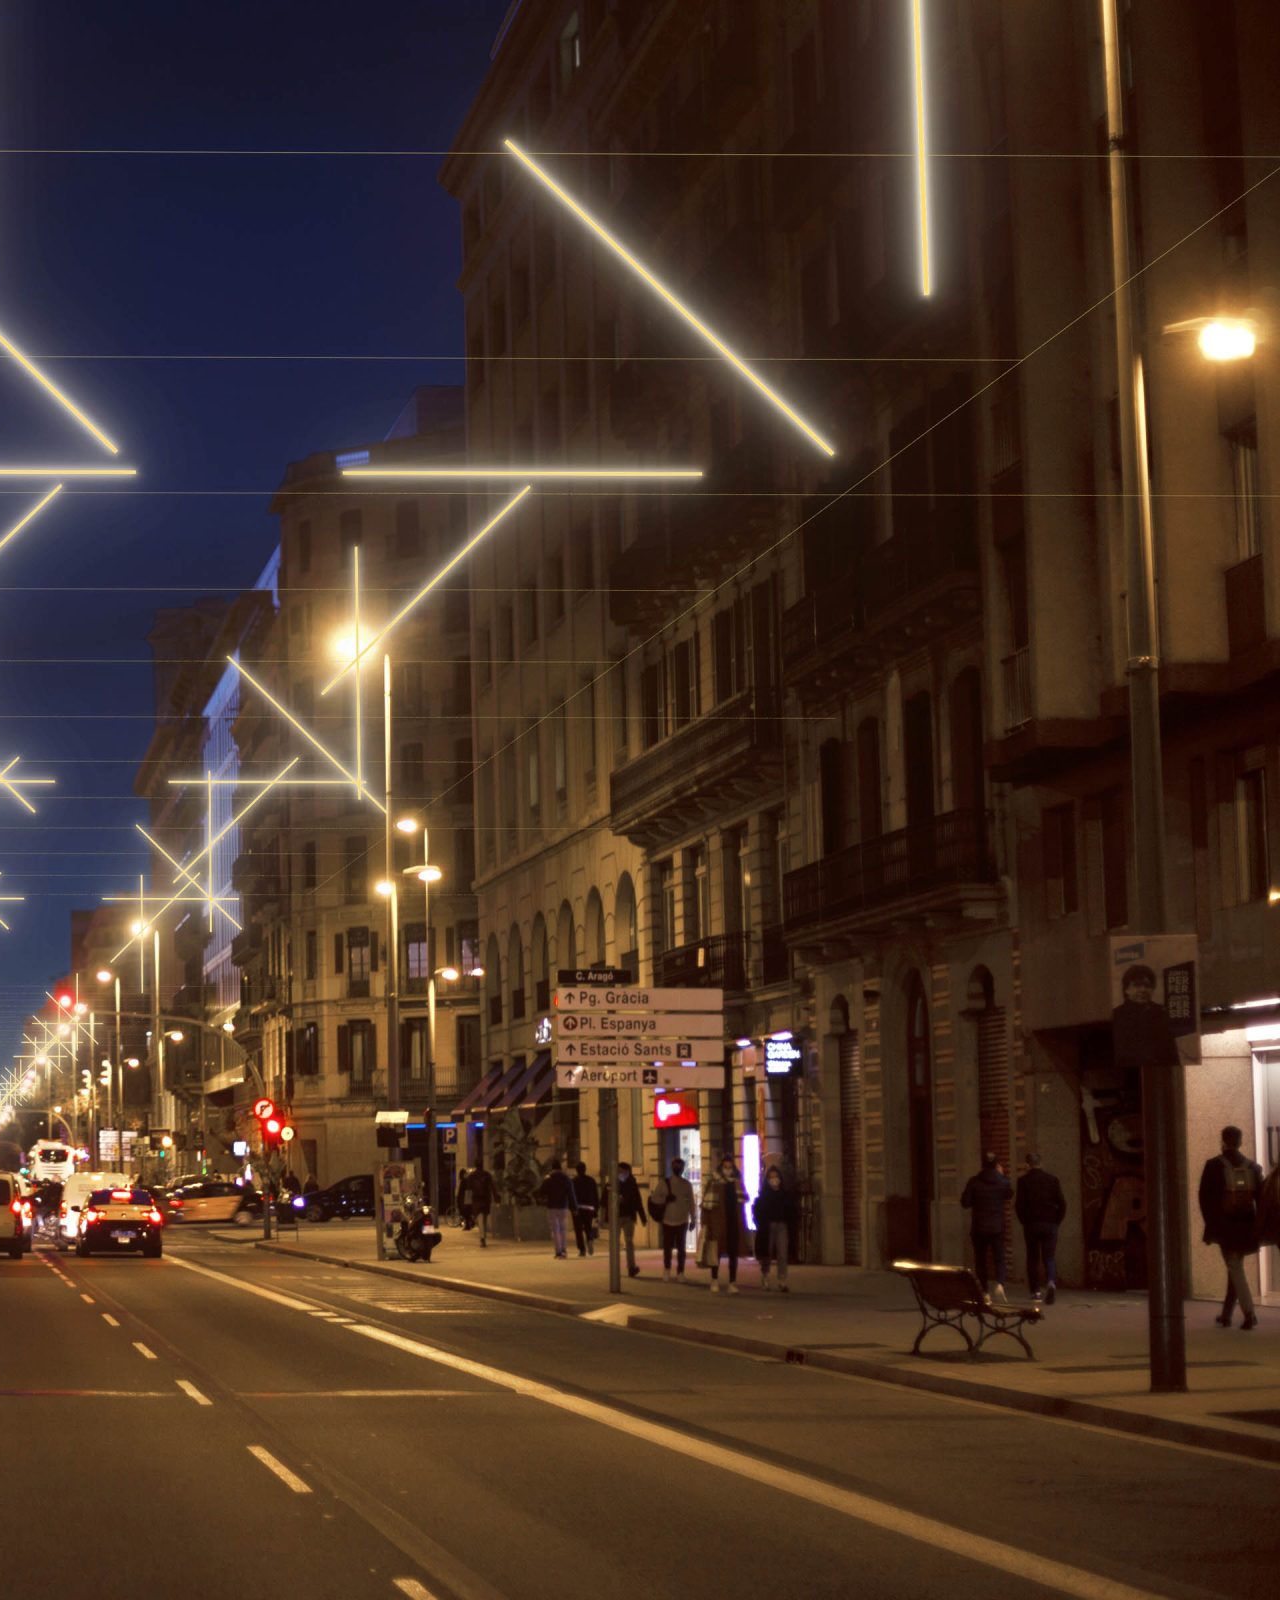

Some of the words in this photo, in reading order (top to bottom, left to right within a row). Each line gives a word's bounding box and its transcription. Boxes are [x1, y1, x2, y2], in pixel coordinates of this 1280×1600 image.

[576, 971, 586, 981] C.
[587, 971, 614, 982] Aragó
[579, 991, 601, 1007] Pg.
[605, 991, 649, 1004] Gràcia
[580, 1016, 596, 1030] Pl.
[601, 1017, 657, 1033] Espanya
[580, 1042, 630, 1057] Estació
[635, 1043, 672, 1057] Sants
[580, 1070, 638, 1085] Aeroport
[445, 1129, 455, 1142] P
